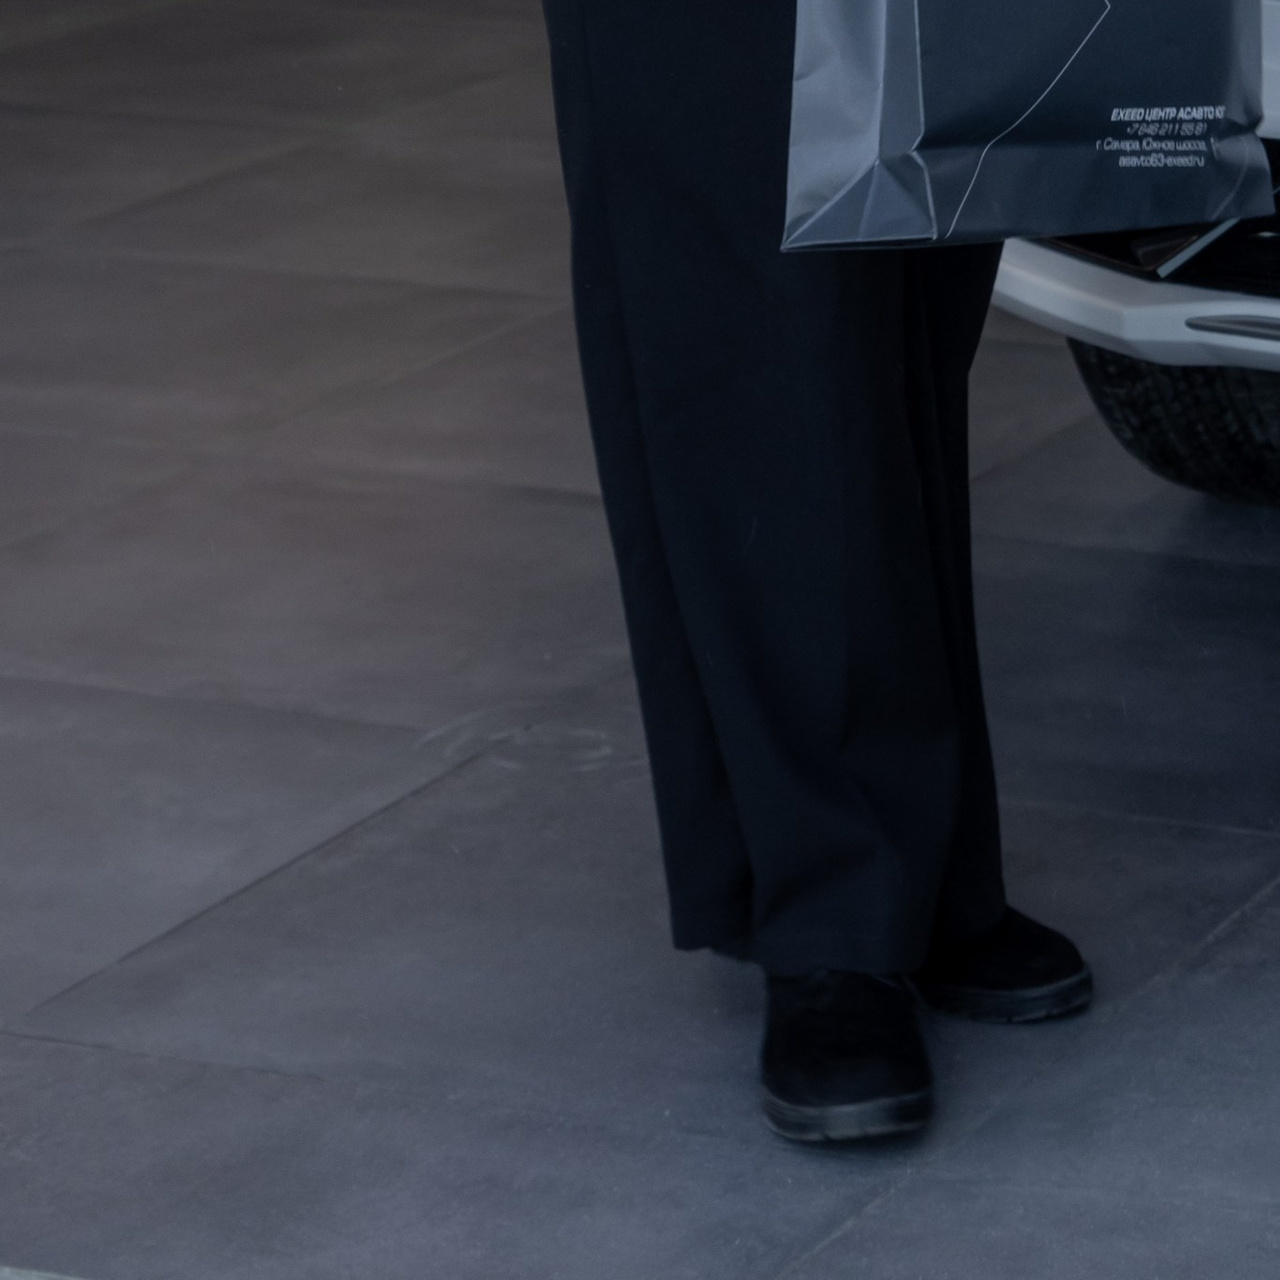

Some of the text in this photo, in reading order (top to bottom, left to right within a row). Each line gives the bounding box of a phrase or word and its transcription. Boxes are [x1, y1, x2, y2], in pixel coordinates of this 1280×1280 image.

[1111, 108, 1145, 121] EXEED
[1144, 107, 1177, 122] ЦЕНТР
[1176, 106, 1215, 120] АСАВТО
[1141, 137, 1175, 151] Южное
